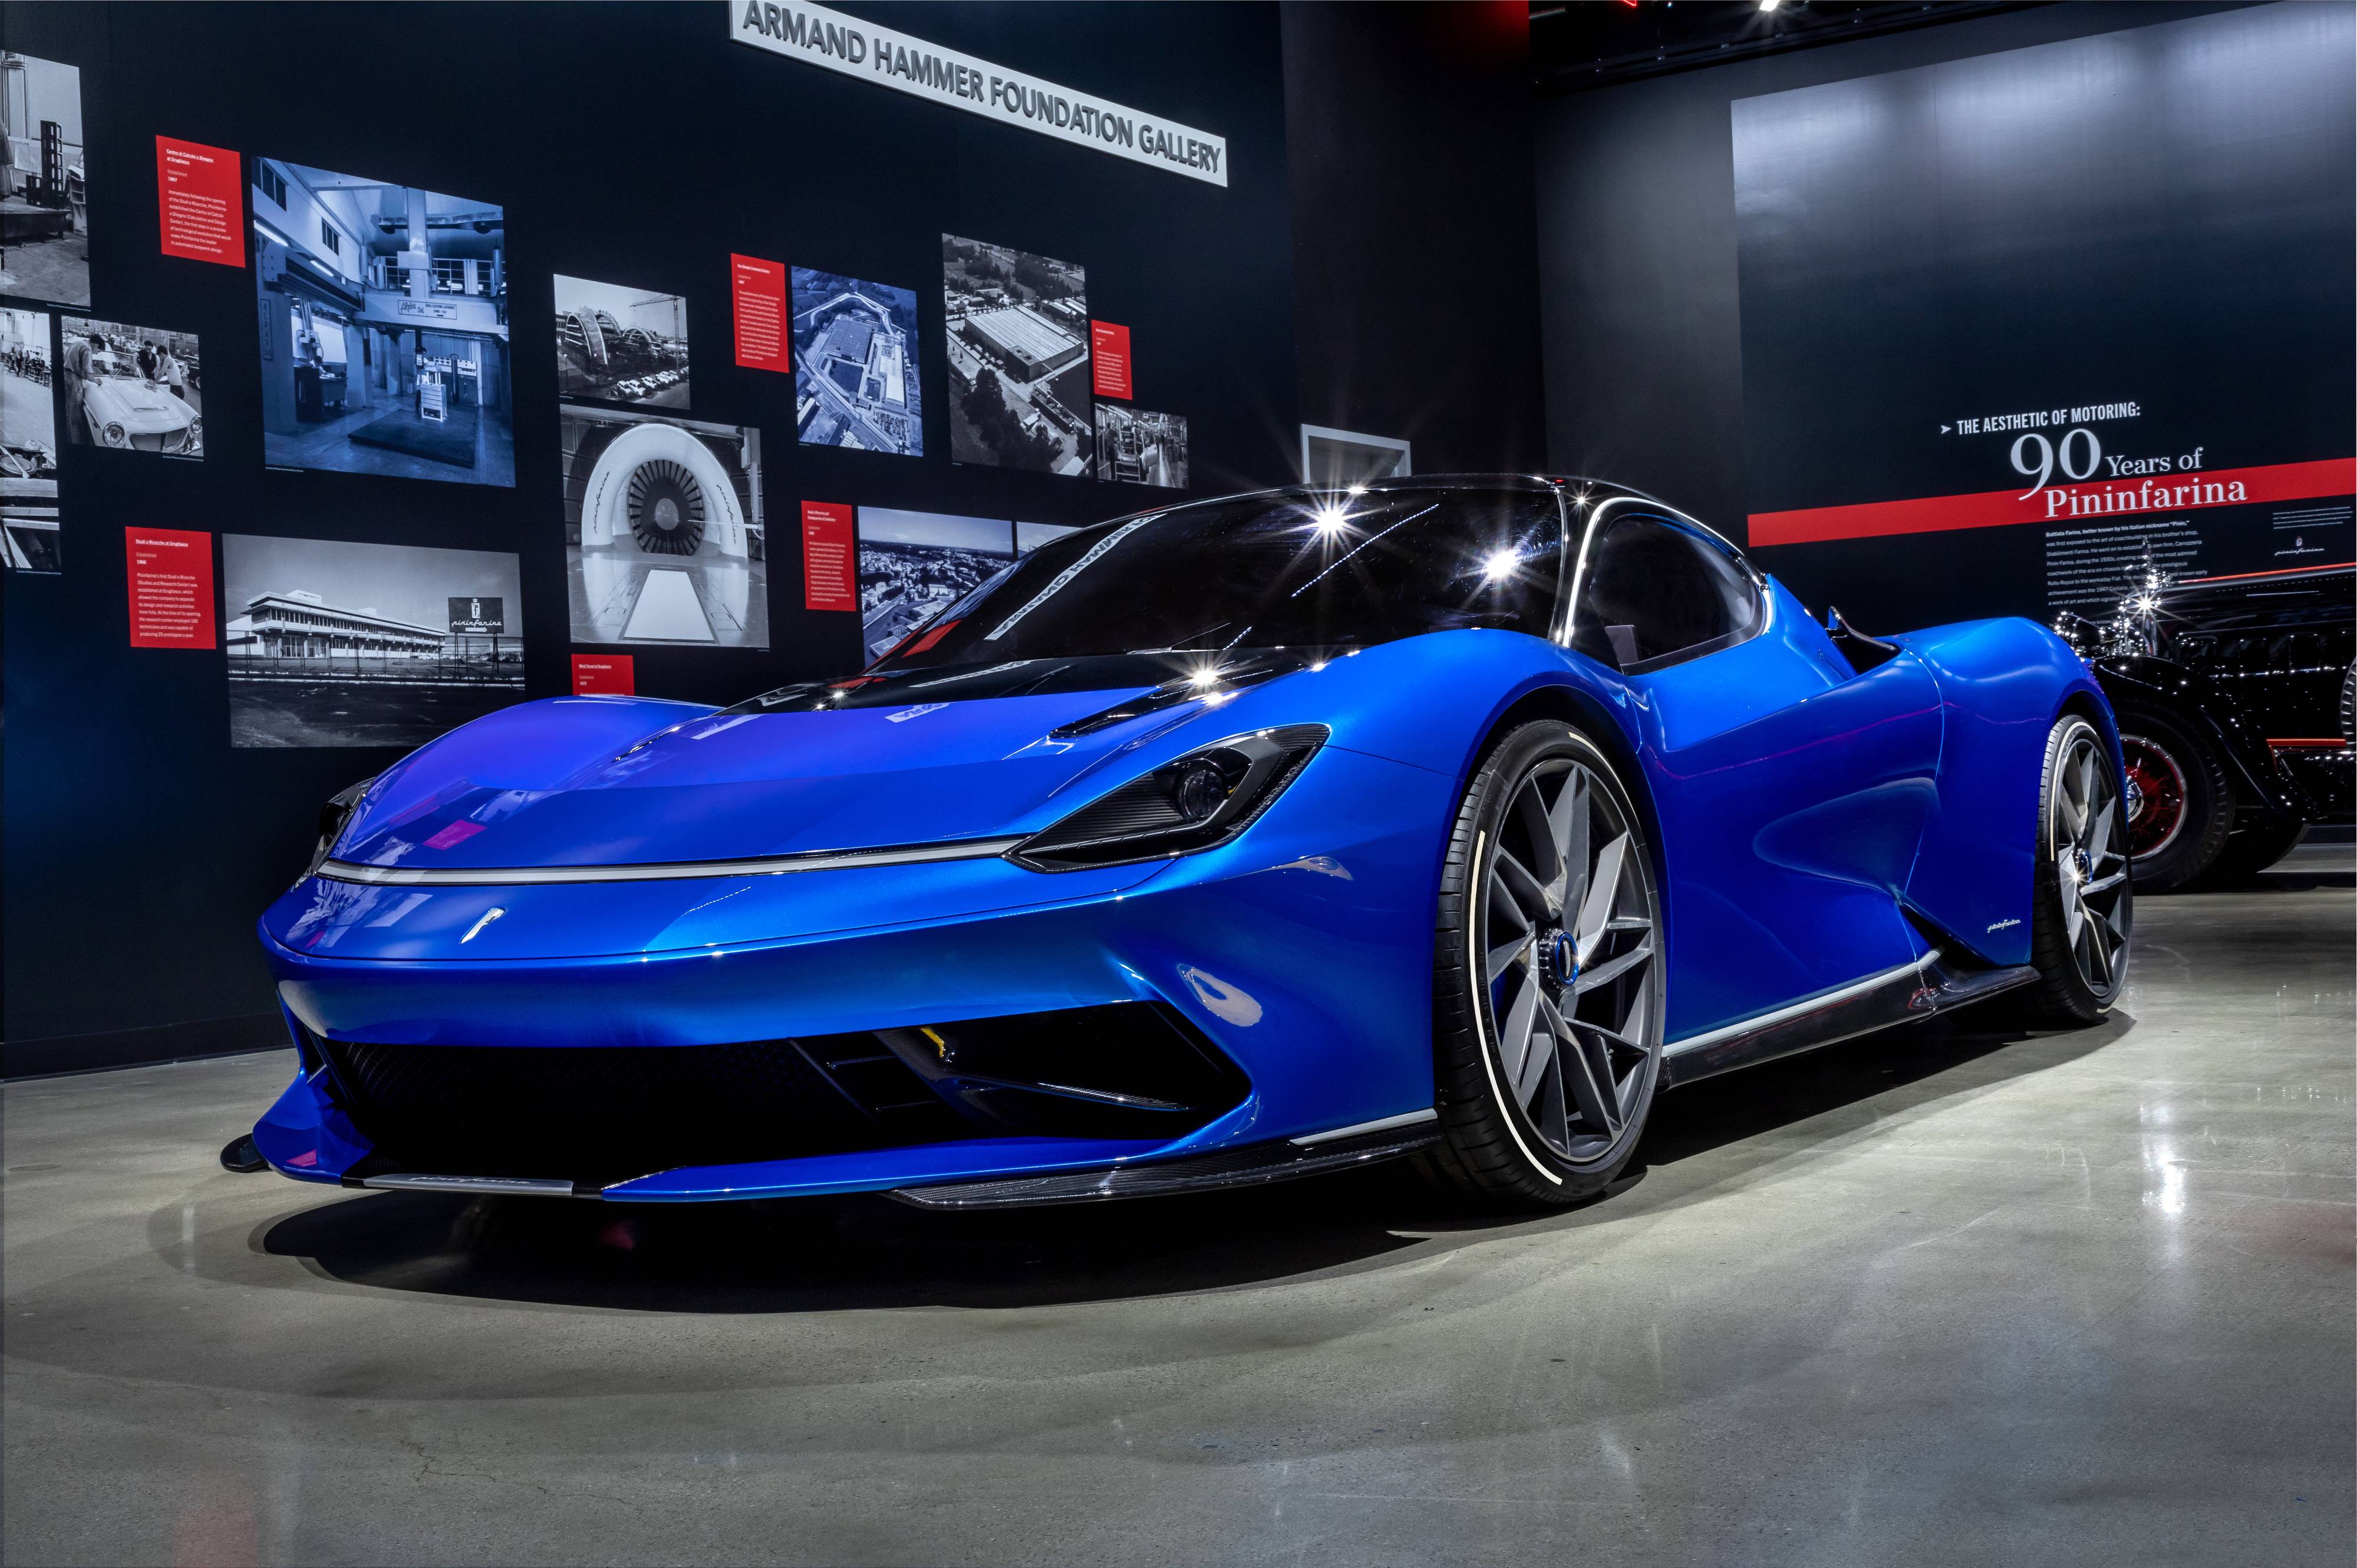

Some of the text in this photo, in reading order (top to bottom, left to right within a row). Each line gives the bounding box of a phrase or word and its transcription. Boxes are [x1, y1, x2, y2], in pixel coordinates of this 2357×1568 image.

[743, 0, 1221, 173] ARMAND HAMMER FOUNDATION GALLERY
[1957, 402, 2141, 435] THE AESTHETIC OF MOTORING:
[2010, 428, 2204, 501] 90 Years of
[2044, 477, 2248, 518] Pininfarina
[451, 619, 502, 628] pininfarina
